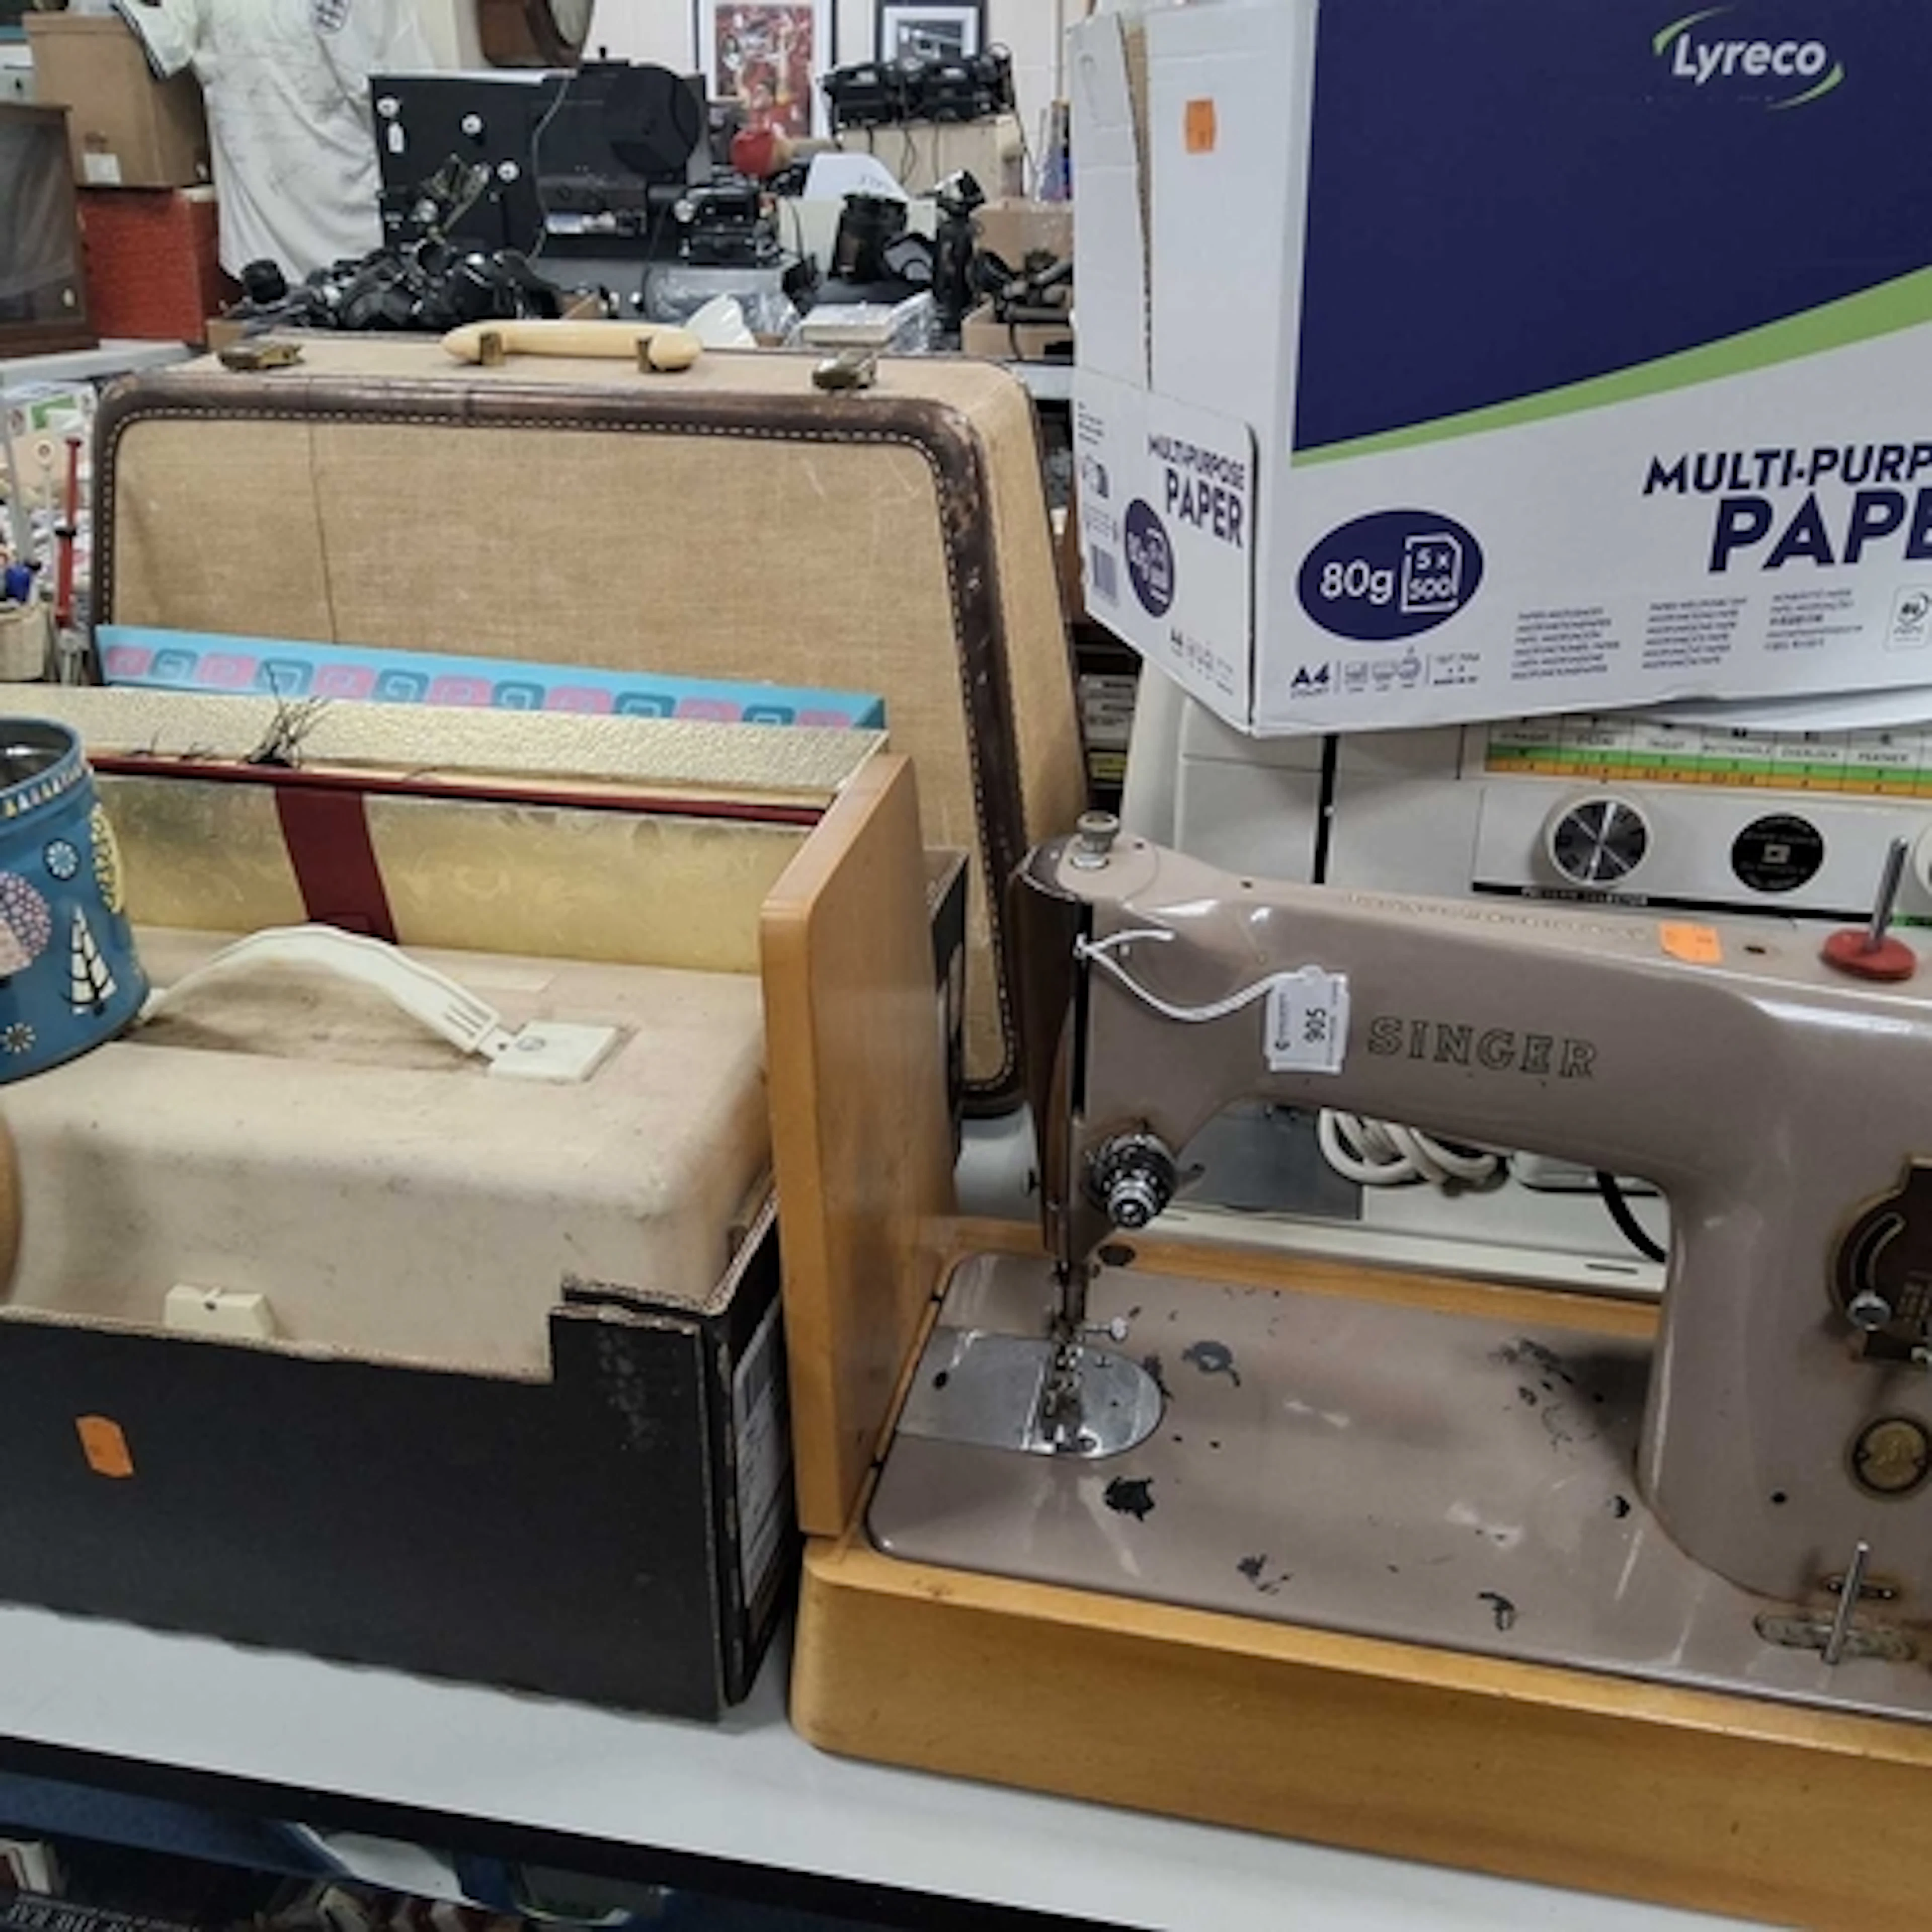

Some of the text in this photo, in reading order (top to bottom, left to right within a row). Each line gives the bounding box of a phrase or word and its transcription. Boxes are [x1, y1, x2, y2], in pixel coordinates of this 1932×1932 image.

[1672, 33, 1826, 86] Lyreco
[1166, 466, 1243, 548] PAPER
[1415, 548, 1431, 570] 5
[1320, 559, 1394, 605] 80g
[1409, 578, 1452, 601] 500
[1290, 661, 1330, 689] A4
[1303, 1006, 1327, 1044] 905
[1369, 1016, 1598, 1078] SINGER
